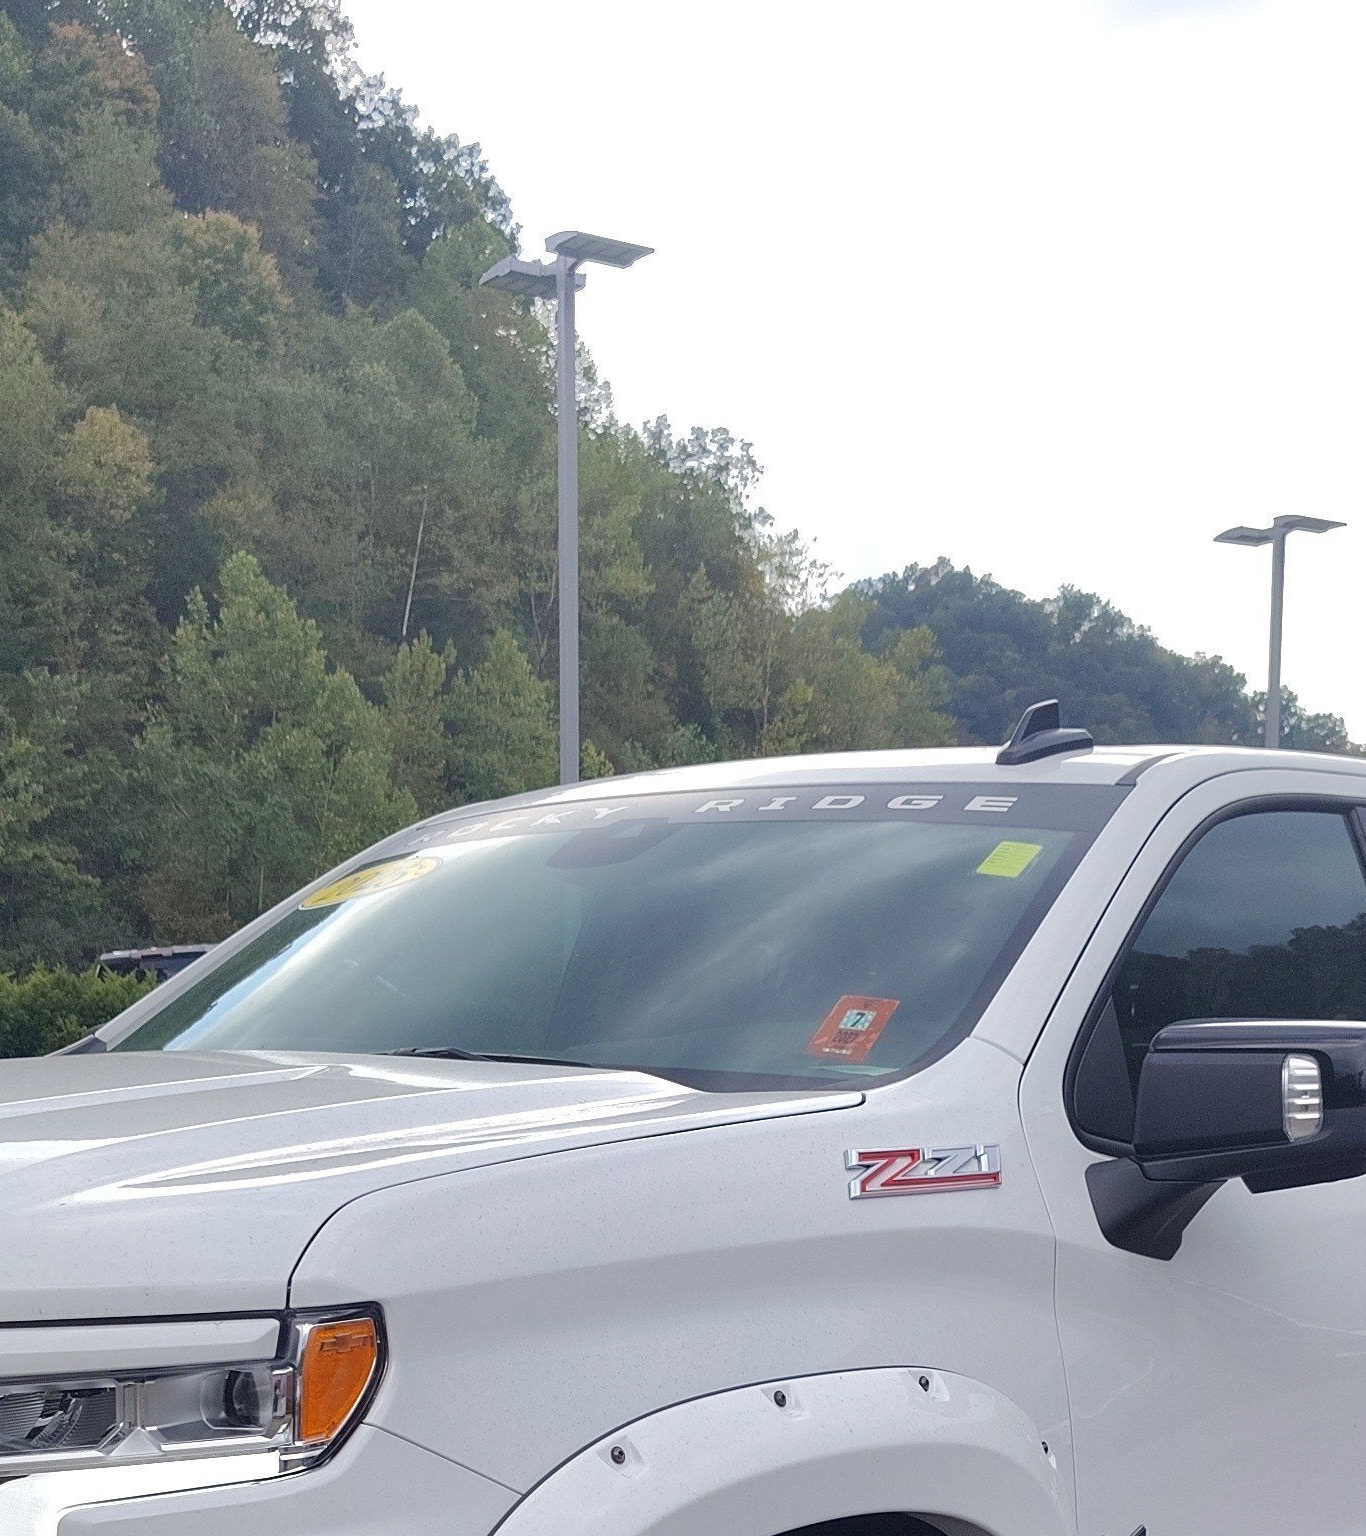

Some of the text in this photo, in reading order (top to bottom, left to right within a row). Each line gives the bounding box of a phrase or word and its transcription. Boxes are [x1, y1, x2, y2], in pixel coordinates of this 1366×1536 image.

[407, 795, 1019, 847] ROCKY RIDGE
[850, 1011, 865, 1028] 7
[844, 1144, 1002, 1200] Z71
